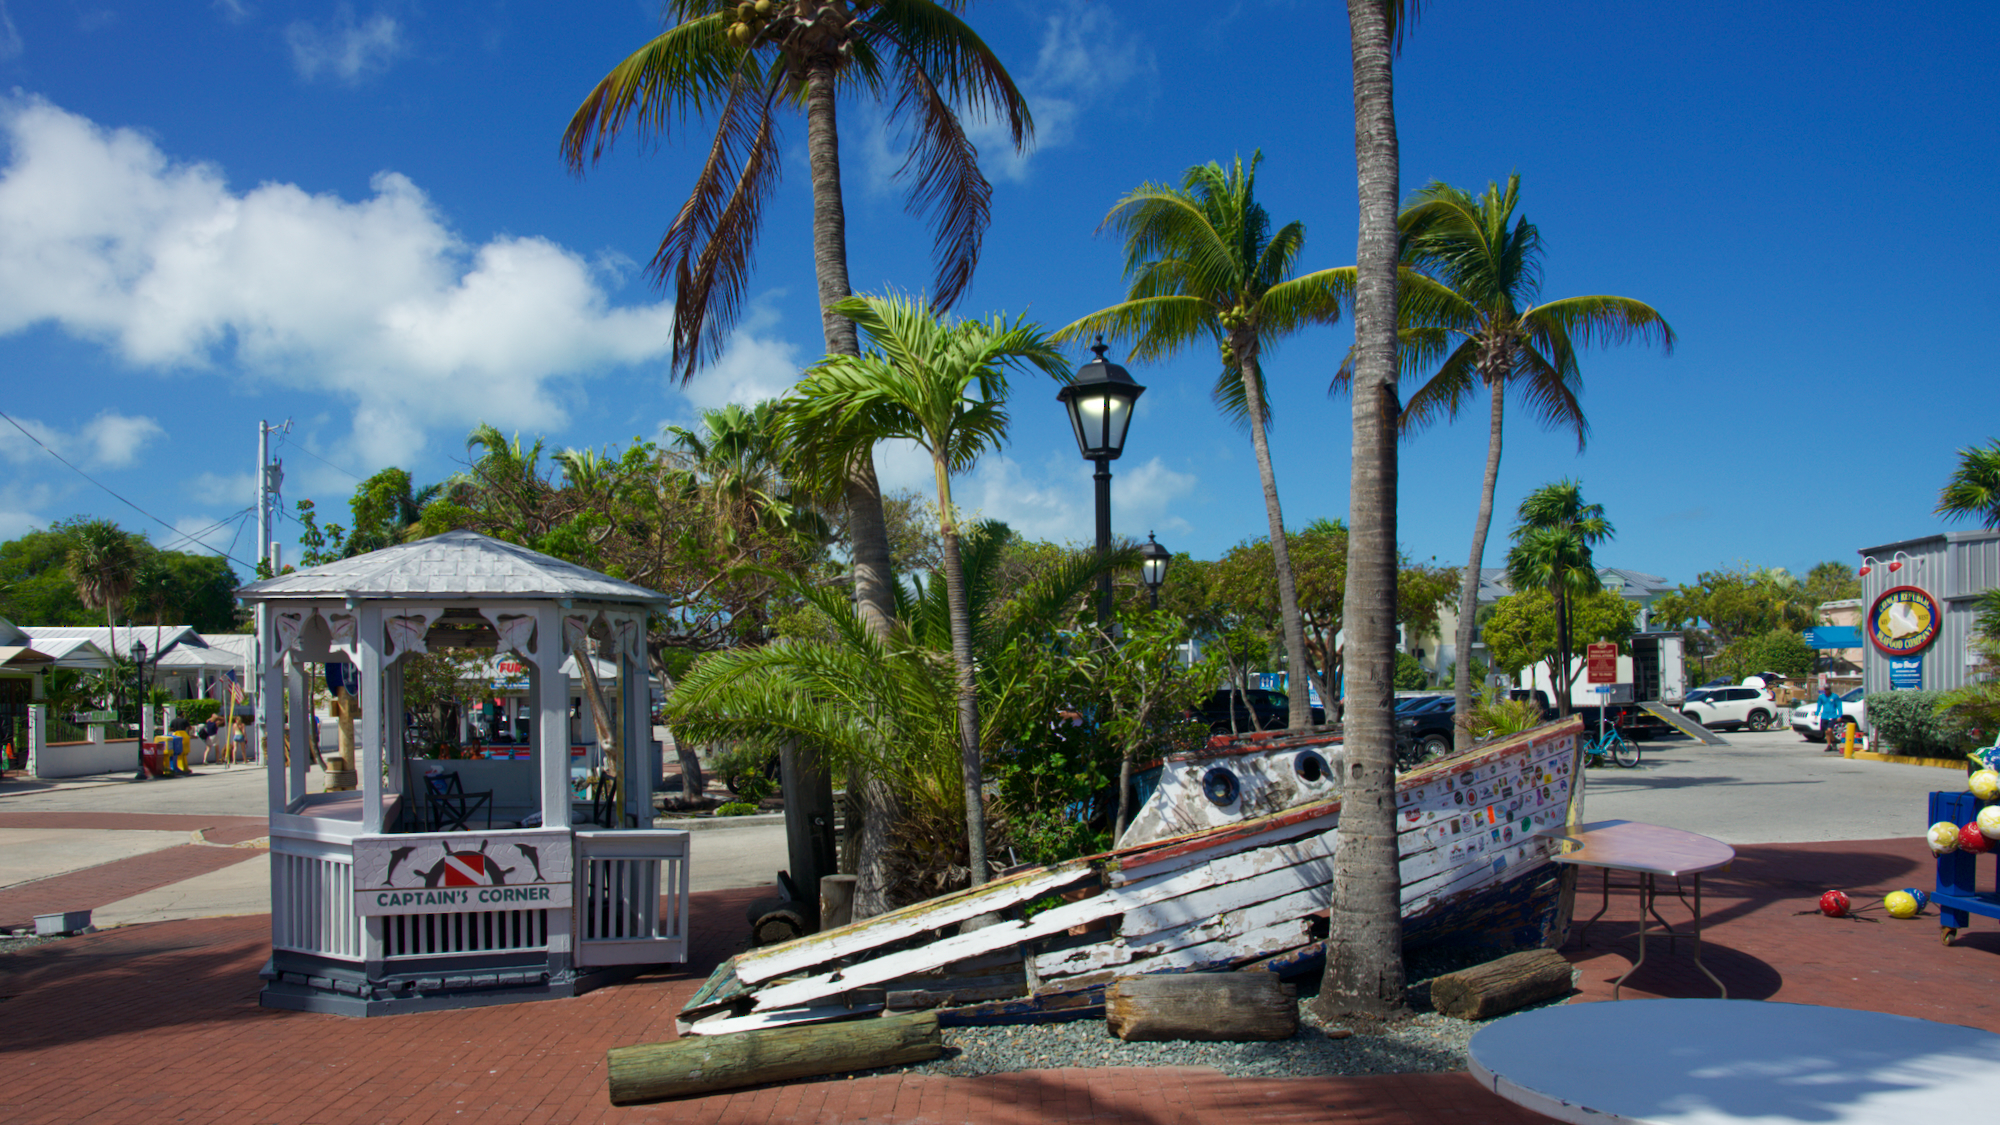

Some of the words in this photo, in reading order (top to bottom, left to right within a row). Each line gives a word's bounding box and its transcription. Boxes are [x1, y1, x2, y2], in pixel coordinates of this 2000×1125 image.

[1878, 592, 1899, 613] CONCH
[1900, 591, 1931, 610] REPUBLIC
[1876, 630, 1903, 649] SEAFOOD
[1904, 623, 1933, 648] COMPANY
[376, 890, 469, 908] CAPTAIN'S
[478, 887, 551, 903] CORNER
